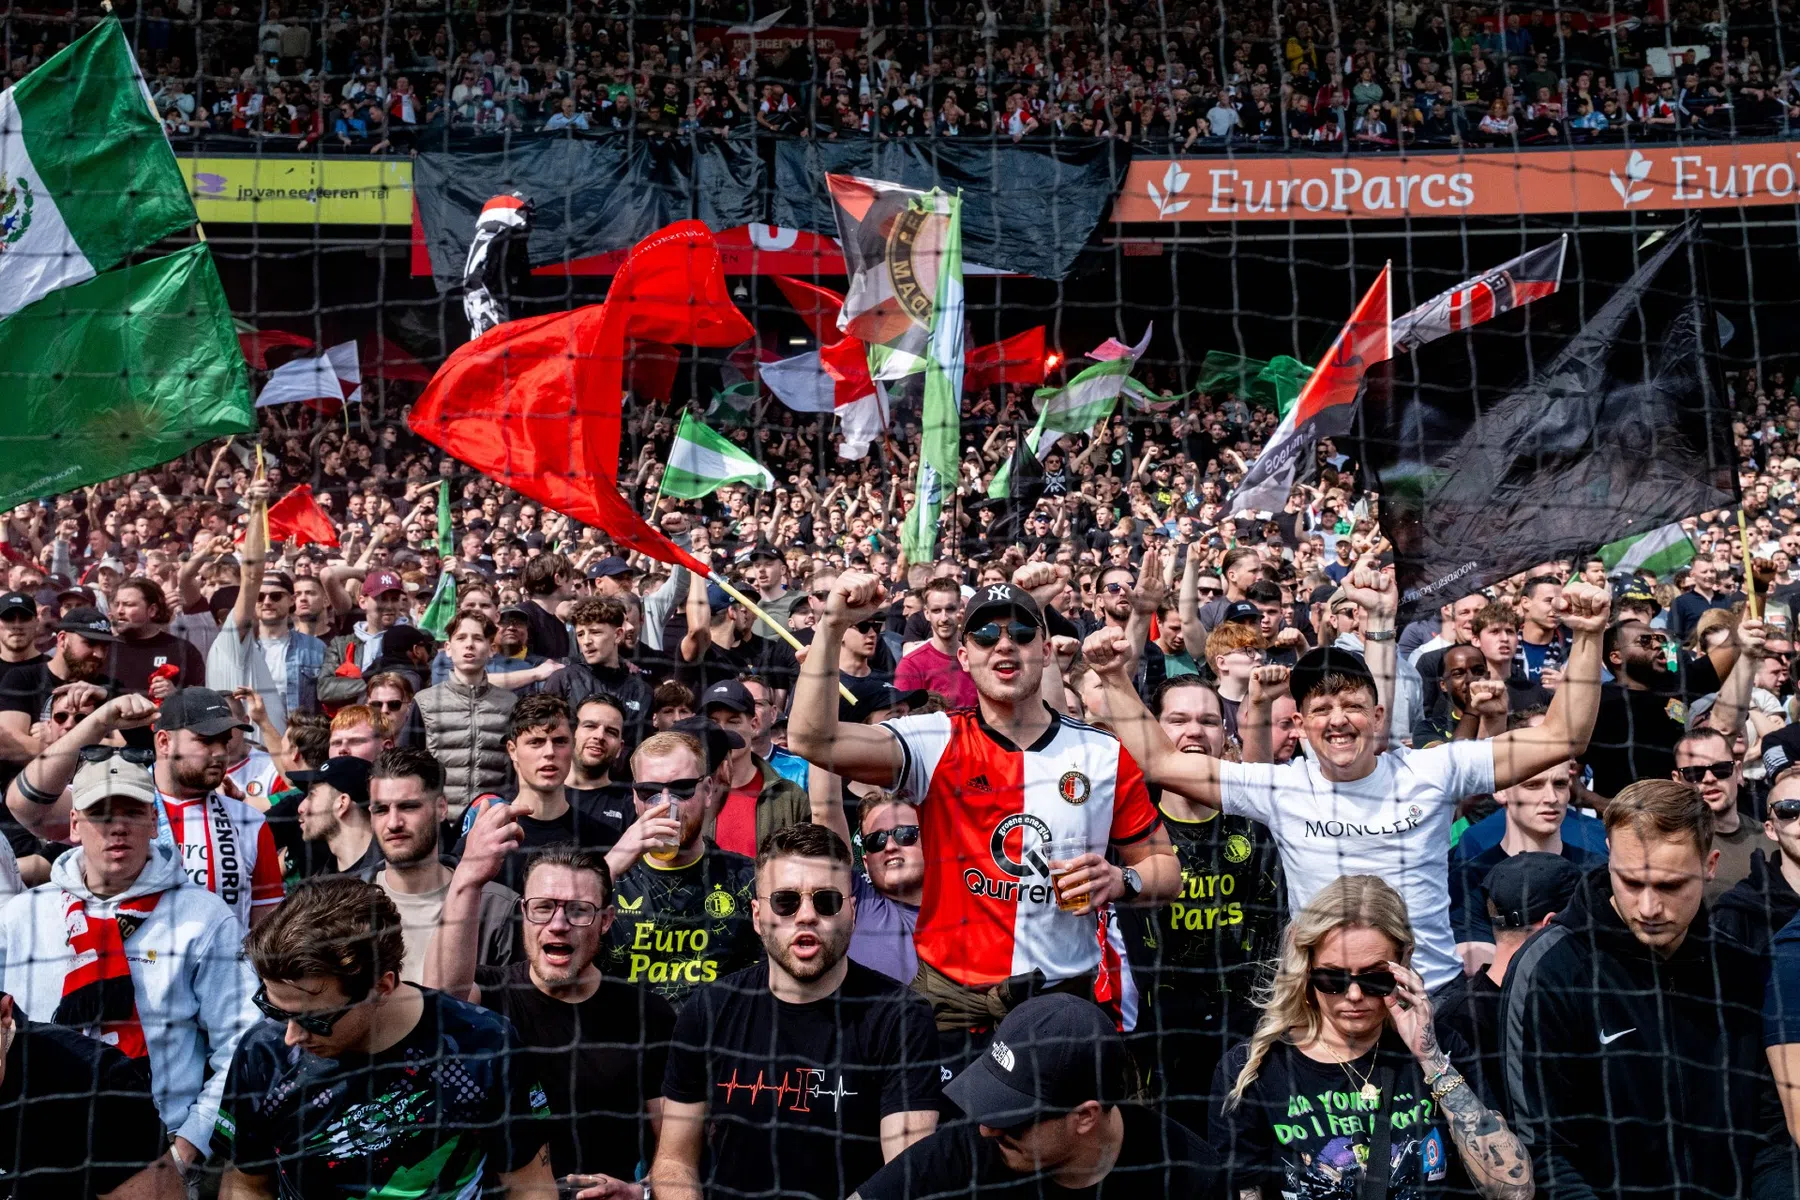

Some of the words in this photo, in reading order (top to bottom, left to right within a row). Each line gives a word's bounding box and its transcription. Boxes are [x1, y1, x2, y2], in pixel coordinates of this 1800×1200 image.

[1207, 166, 1475, 214] EuroParcs
[1671, 152, 1799, 200] Euro
[238, 185, 253, 201] jp
[255, 190, 285, 199] van
[998, 817, 1023, 837] groene
[1024, 817, 1050, 841] energie
[963, 868, 1054, 904] Qurren
[1170, 902, 1244, 931] Parcs
[631, 922, 709, 953] Euro
[627, 954, 718, 983] Parcs
[1274, 1124, 1308, 1145] DO
[1310, 1115, 1325, 1137] I
